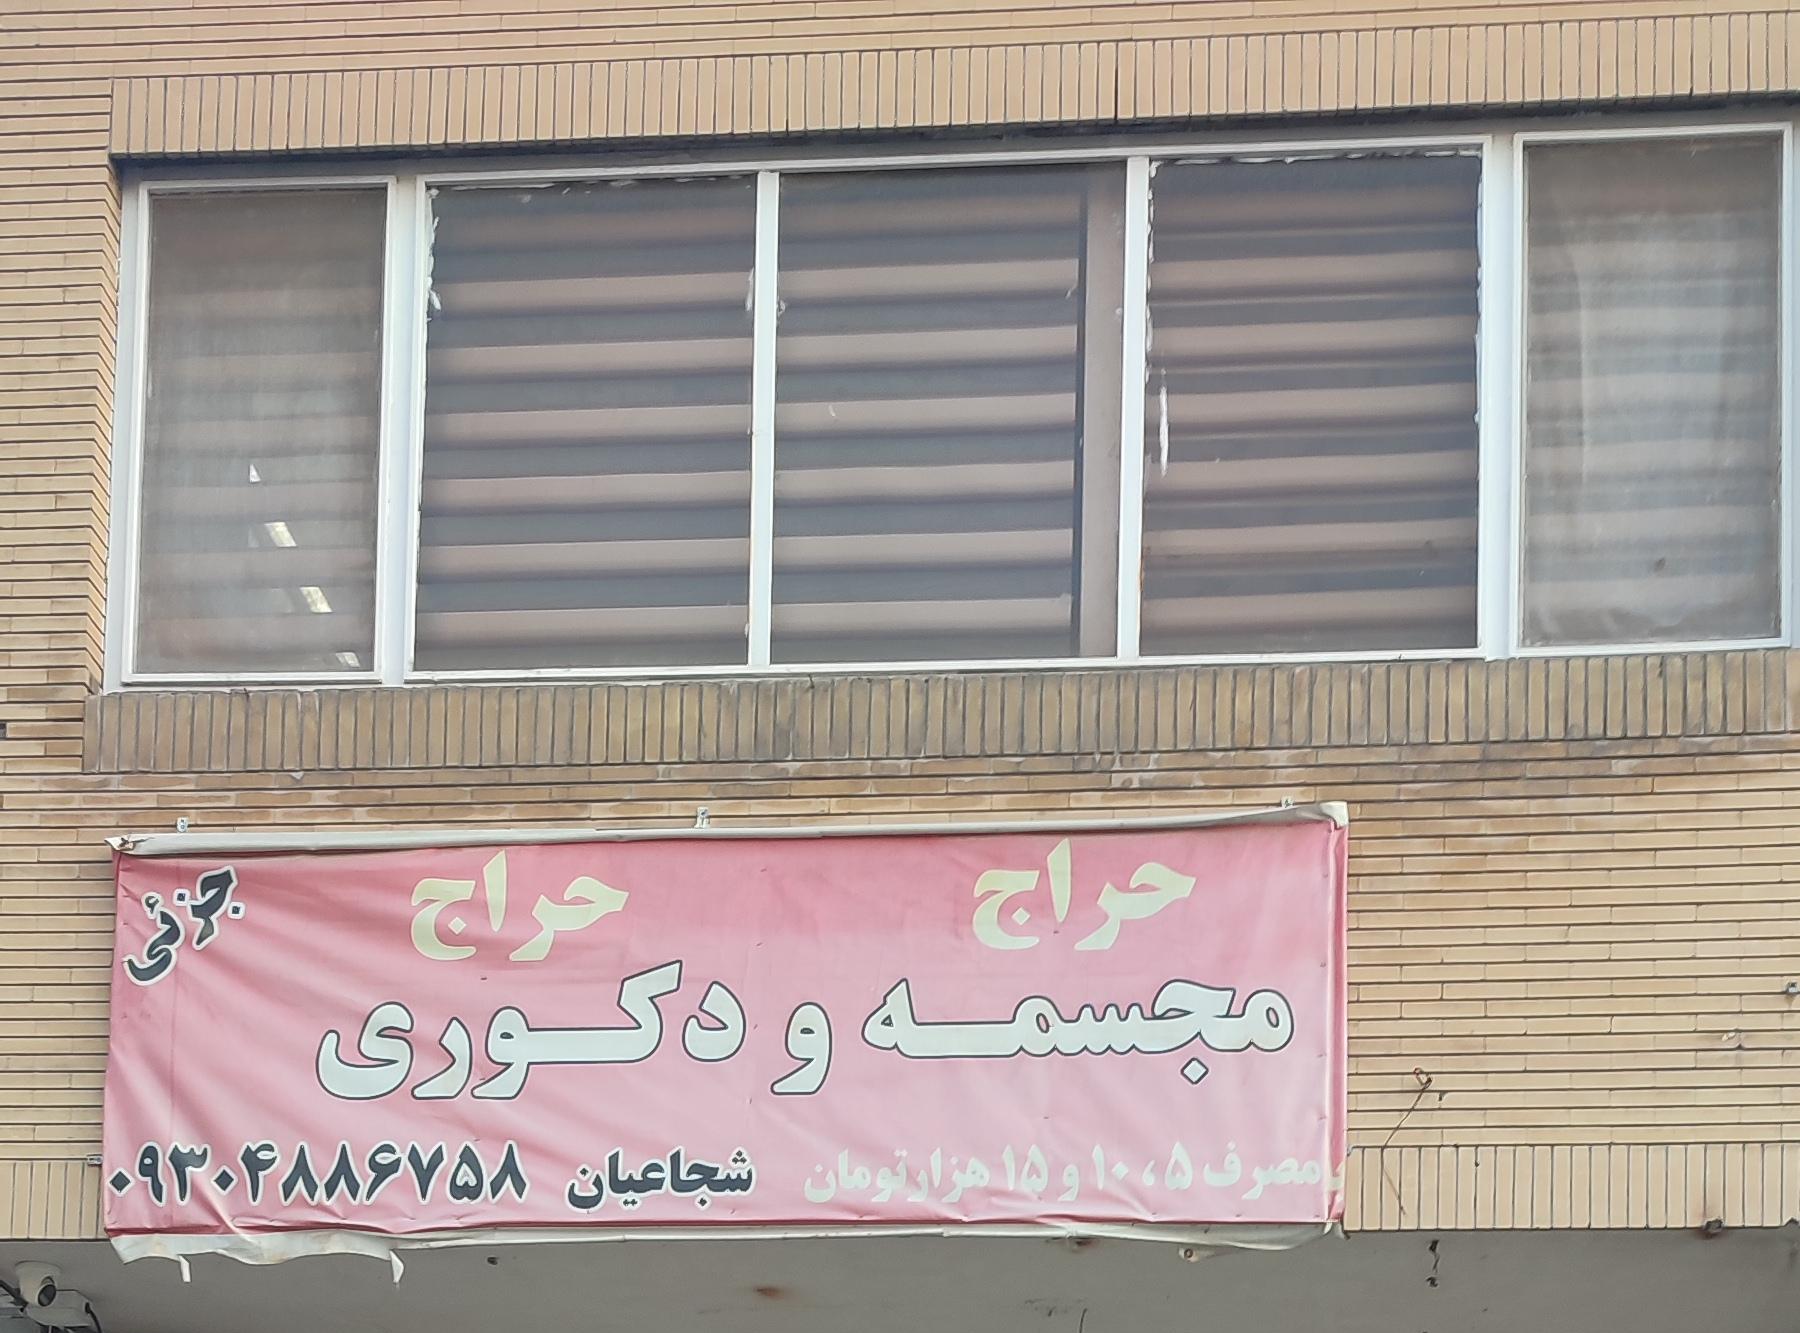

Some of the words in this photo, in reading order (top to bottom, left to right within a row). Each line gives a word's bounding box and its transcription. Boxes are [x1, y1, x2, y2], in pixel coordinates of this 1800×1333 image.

[410, 850, 629, 962] حراج
[972, 838, 1197, 950] حراج
[316, 960, 746, 1100] دکوری
[770, 1002, 832, 1095] و
[862, 977, 1294, 1085] مجسمه
[107, 1141, 529, 1206] ۰۹۳۰۴۸۸۶۷۵۸
[566, 1146, 755, 1209] شجاعیان
[1057, 1162, 1080, 1202] و
[1201, 1140, 1322, 1200] مصرف
